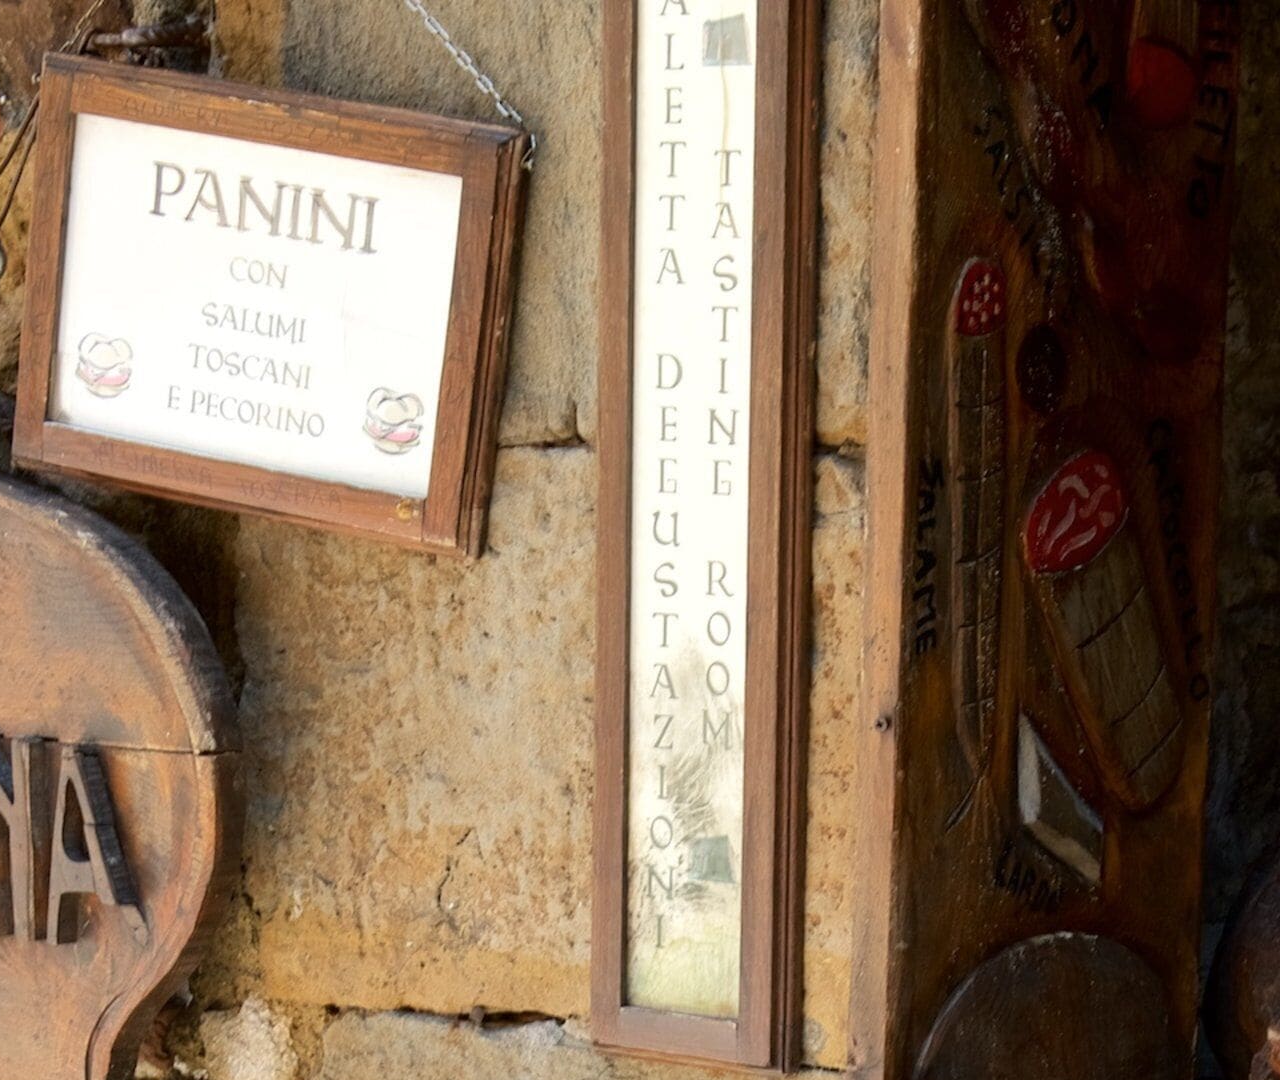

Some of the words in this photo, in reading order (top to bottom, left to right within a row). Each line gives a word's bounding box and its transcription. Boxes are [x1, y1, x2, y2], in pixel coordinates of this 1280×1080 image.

[150, 161, 380, 254] PANINI
[229, 256, 289, 290] CON
[200, 302, 307, 344] SALUMI
[708, 149, 742, 497] TASTING
[188, 343, 311, 390] TOSCANI
[167, 385, 181, 411] E
[191, 391, 325, 438] PECORINO
[648, 353, 683, 948] DEGUSTAZIONI
[701, 560, 735, 752] ROOM
